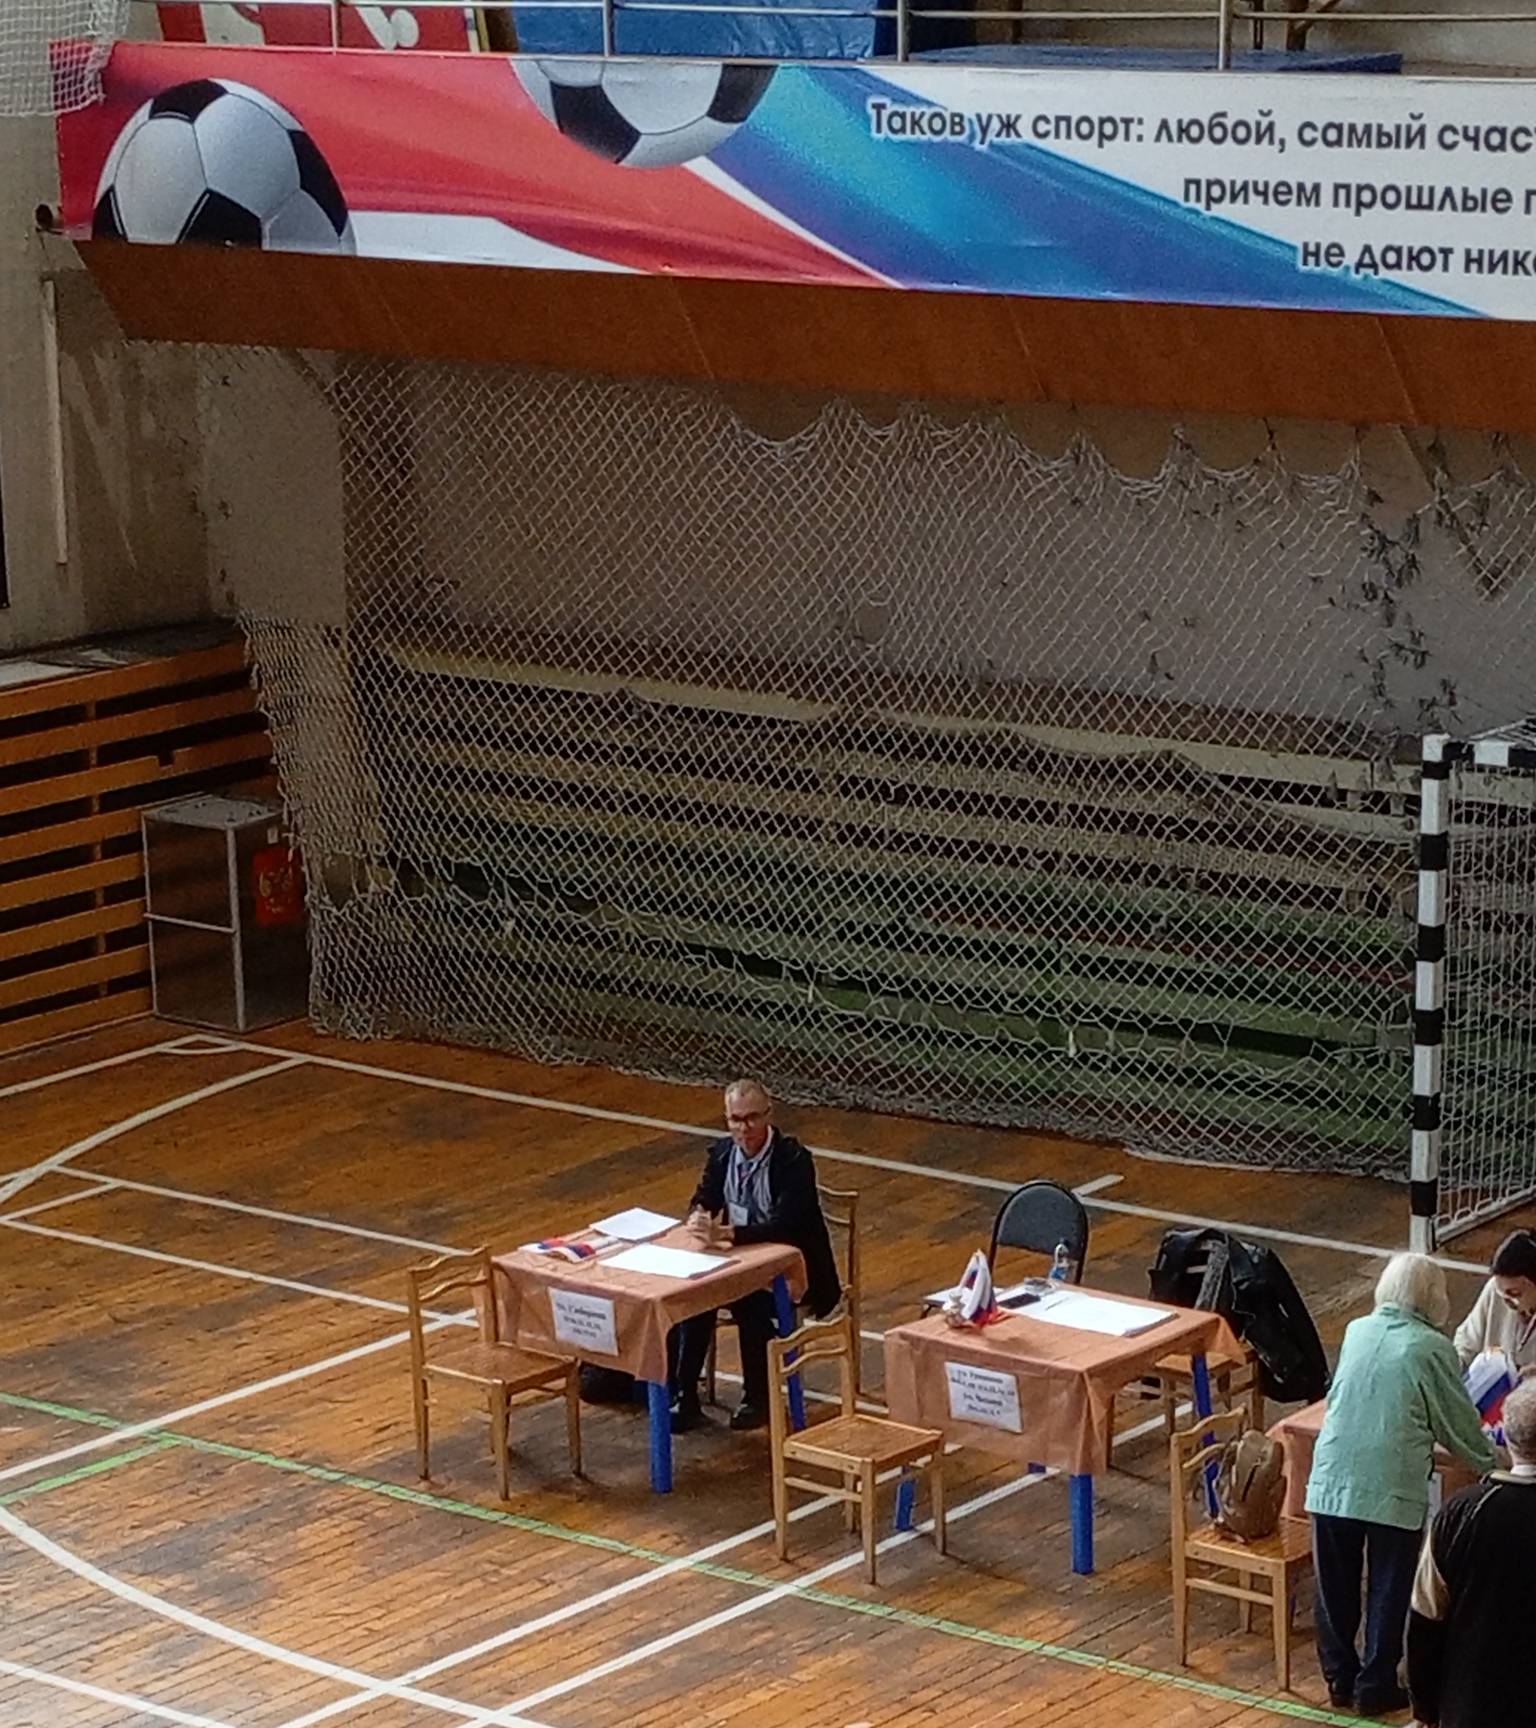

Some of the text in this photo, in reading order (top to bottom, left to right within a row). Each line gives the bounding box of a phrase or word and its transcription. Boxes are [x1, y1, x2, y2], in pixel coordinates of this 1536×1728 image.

[870, 101, 965, 140] Таков
[976, 110, 1024, 148] уж
[1032, 113, 1146, 150] спорт:
[1153, 108, 1286, 154] любой,
[1297, 112, 1427, 150] самый
[1181, 173, 1322, 212] причем
[1332, 182, 1513, 217] прошлые
[1301, 238, 1347, 271] не
[1354, 243, 1455, 283] дают
